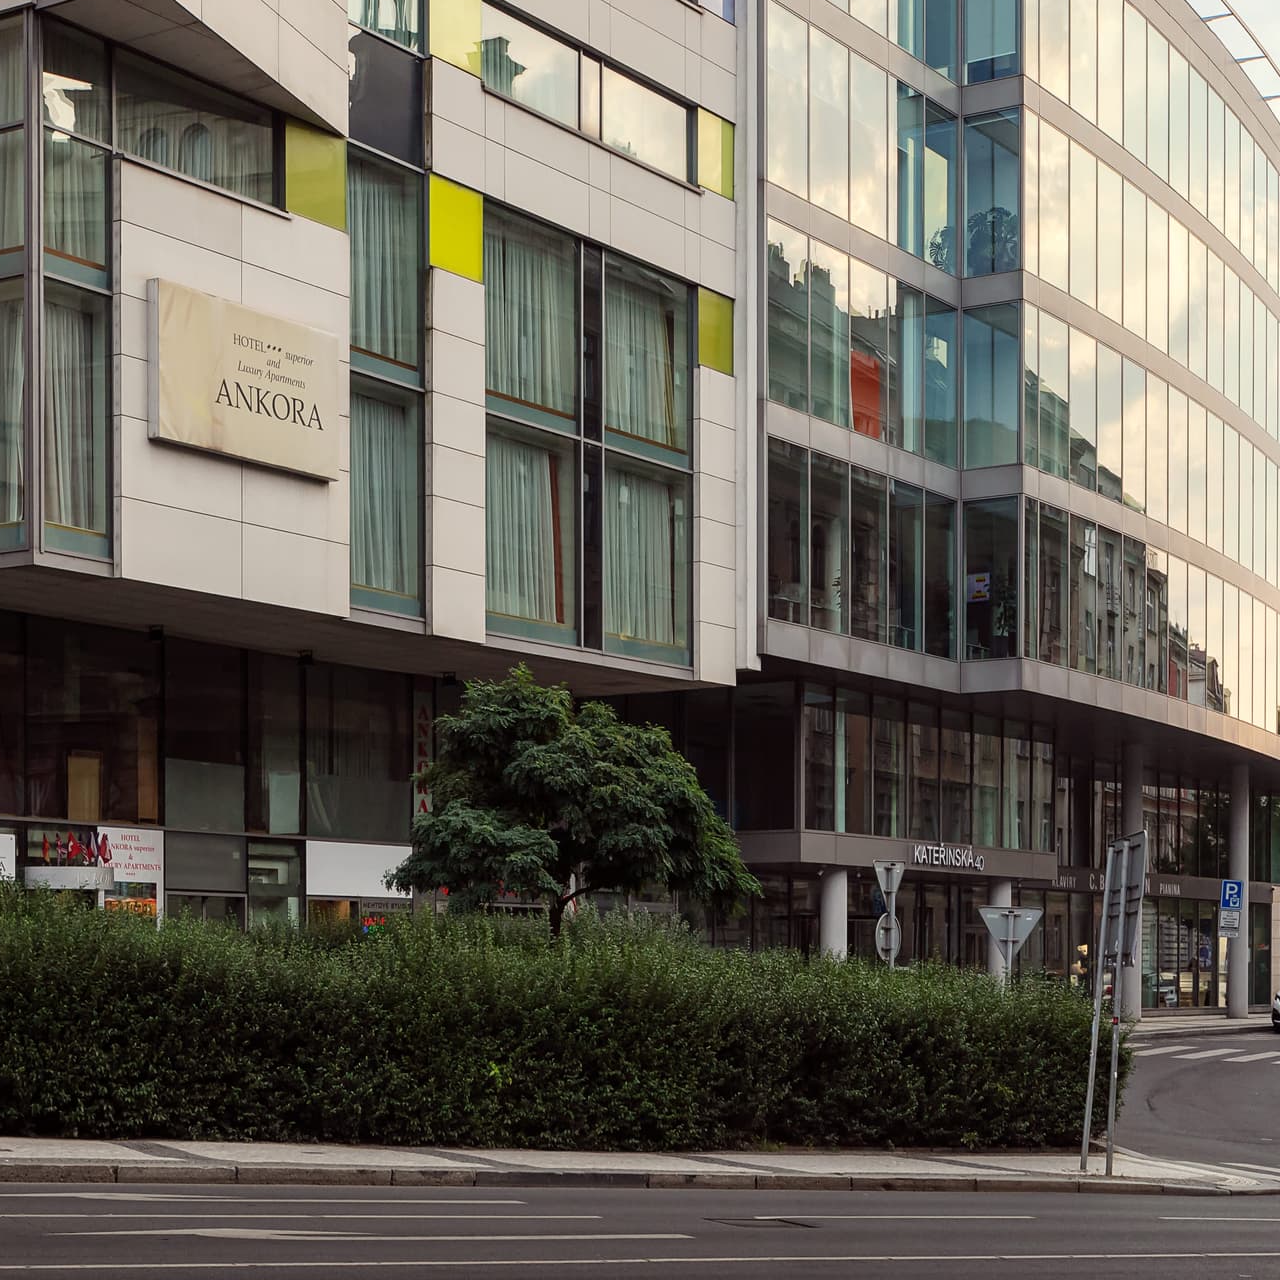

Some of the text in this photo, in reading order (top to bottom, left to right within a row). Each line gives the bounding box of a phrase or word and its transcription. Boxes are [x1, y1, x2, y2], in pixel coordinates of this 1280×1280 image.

[233, 333, 315, 368] HOTEL superior
[266, 357, 281, 370] and
[237, 360, 306, 390] Luxury Apartments
[215, 378, 325, 431] ANKORA
[121, 834, 140, 842] HOTEL
[111, 843, 133, 851] NKORA
[914, 842, 985, 872] KATEŘINSKÁ 40
[123, 863, 162, 871] APARTMENTS
[1225, 883, 1239, 900] P
